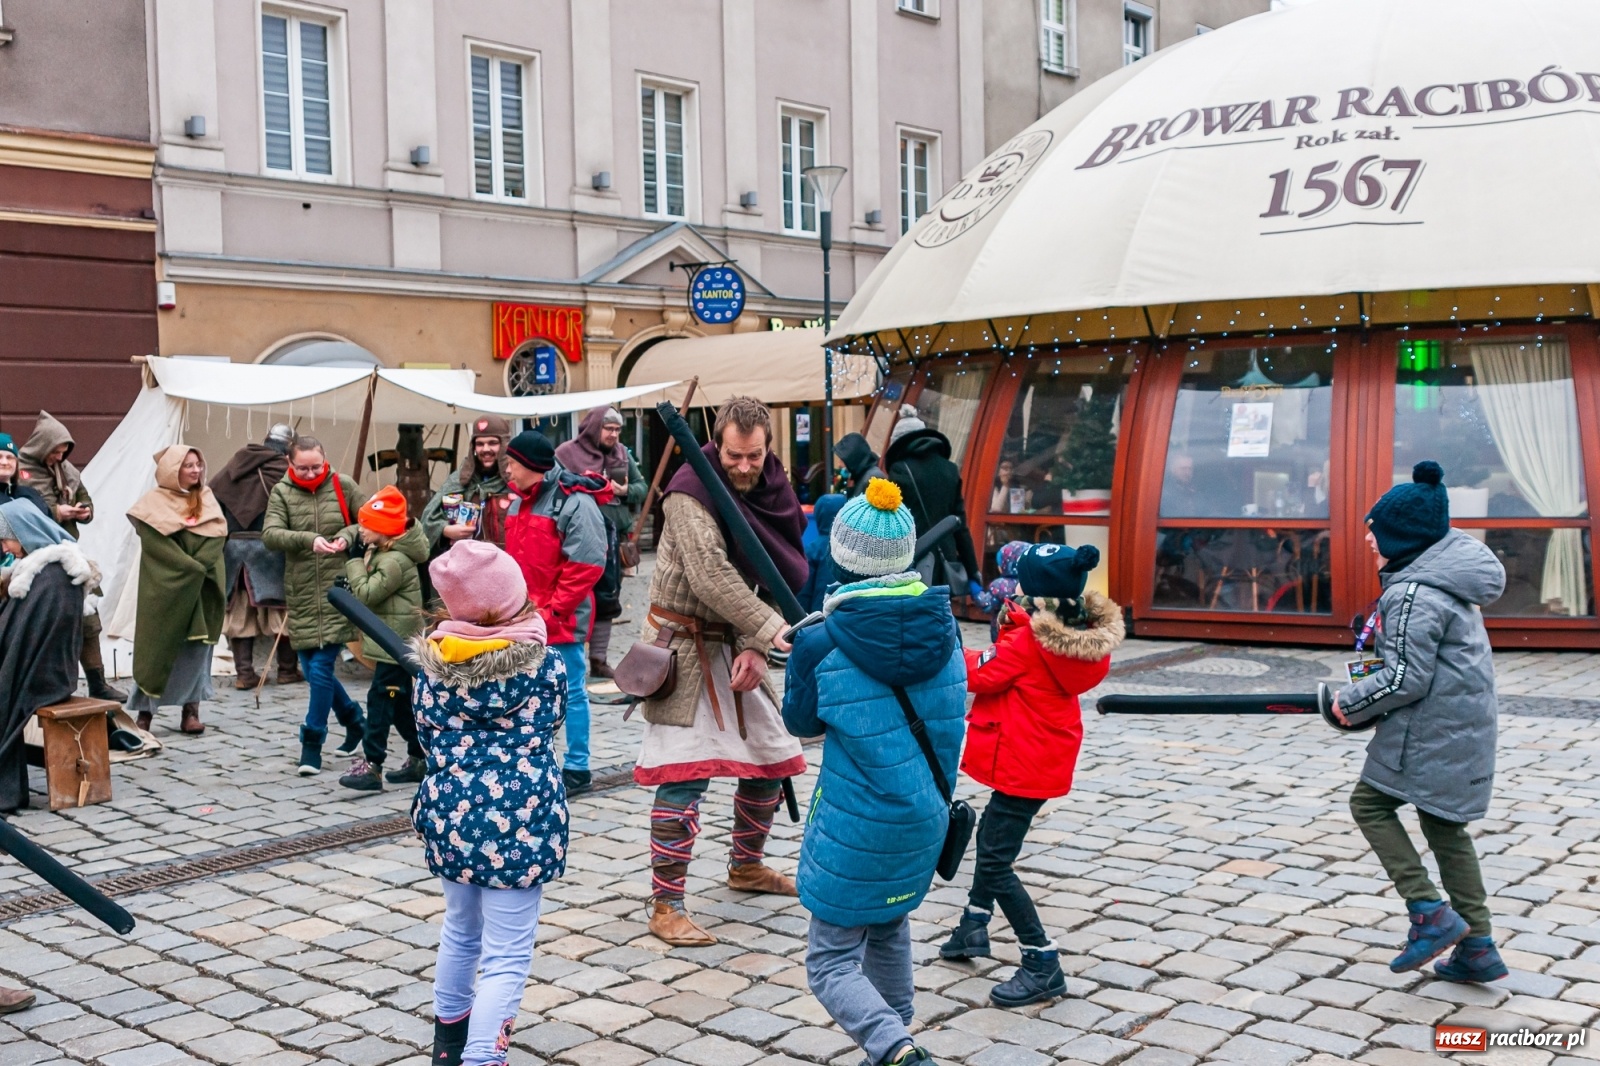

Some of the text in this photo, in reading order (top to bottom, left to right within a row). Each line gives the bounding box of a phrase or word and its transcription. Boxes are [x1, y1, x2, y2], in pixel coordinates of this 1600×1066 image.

[1074, 95, 1322, 170] BROWAR
[1294, 126, 1400, 149] Rok zał.
[1259, 154, 1427, 220] 1567
[702, 289, 734, 299] KANTOR
[498, 304, 584, 358] KANTOR
